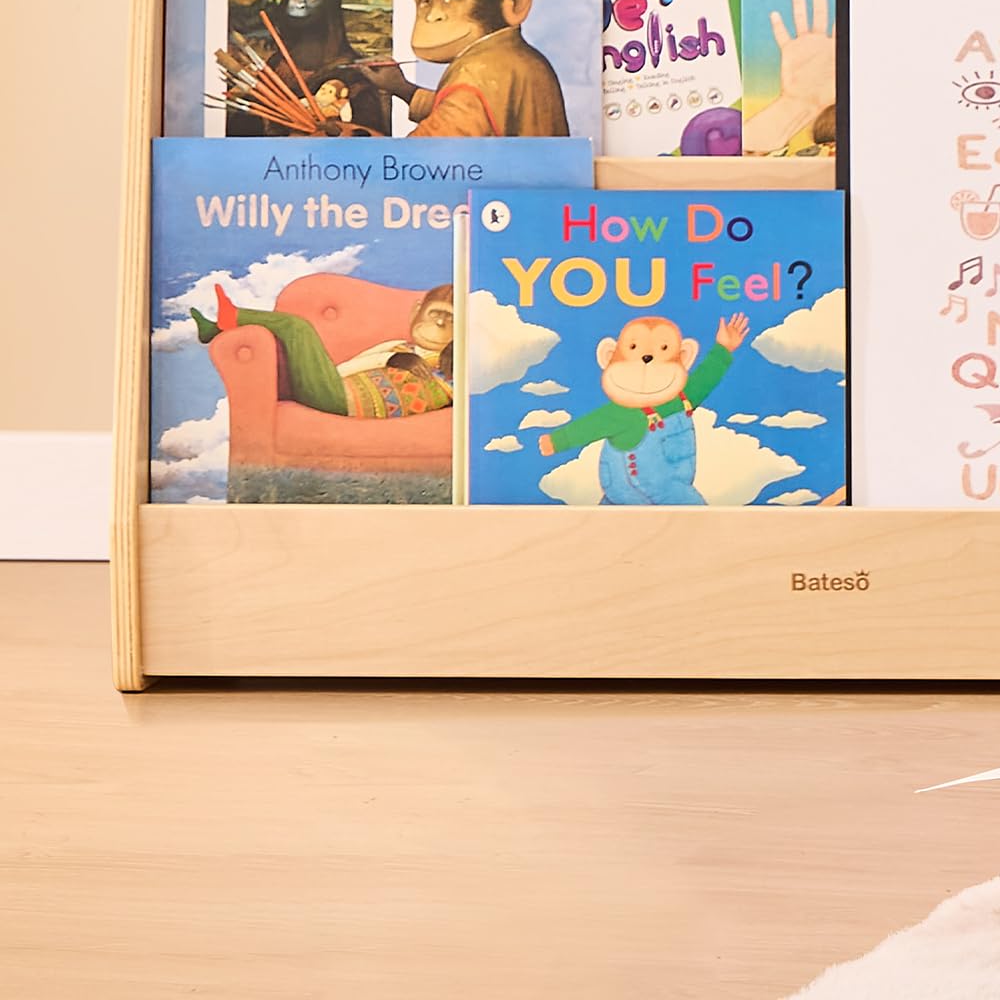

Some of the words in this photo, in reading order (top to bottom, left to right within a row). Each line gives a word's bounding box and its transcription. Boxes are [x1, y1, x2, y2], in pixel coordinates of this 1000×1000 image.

[263, 154, 373, 188] Anthony
[383, 155, 483, 181] Browne
[196, 194, 293, 237] Willy
[304, 194, 368, 229] the
[562, 204, 669, 242] How
[687, 204, 754, 242] Do
[502, 257, 666, 307] YOU
[692, 260, 813, 301] Feel?
